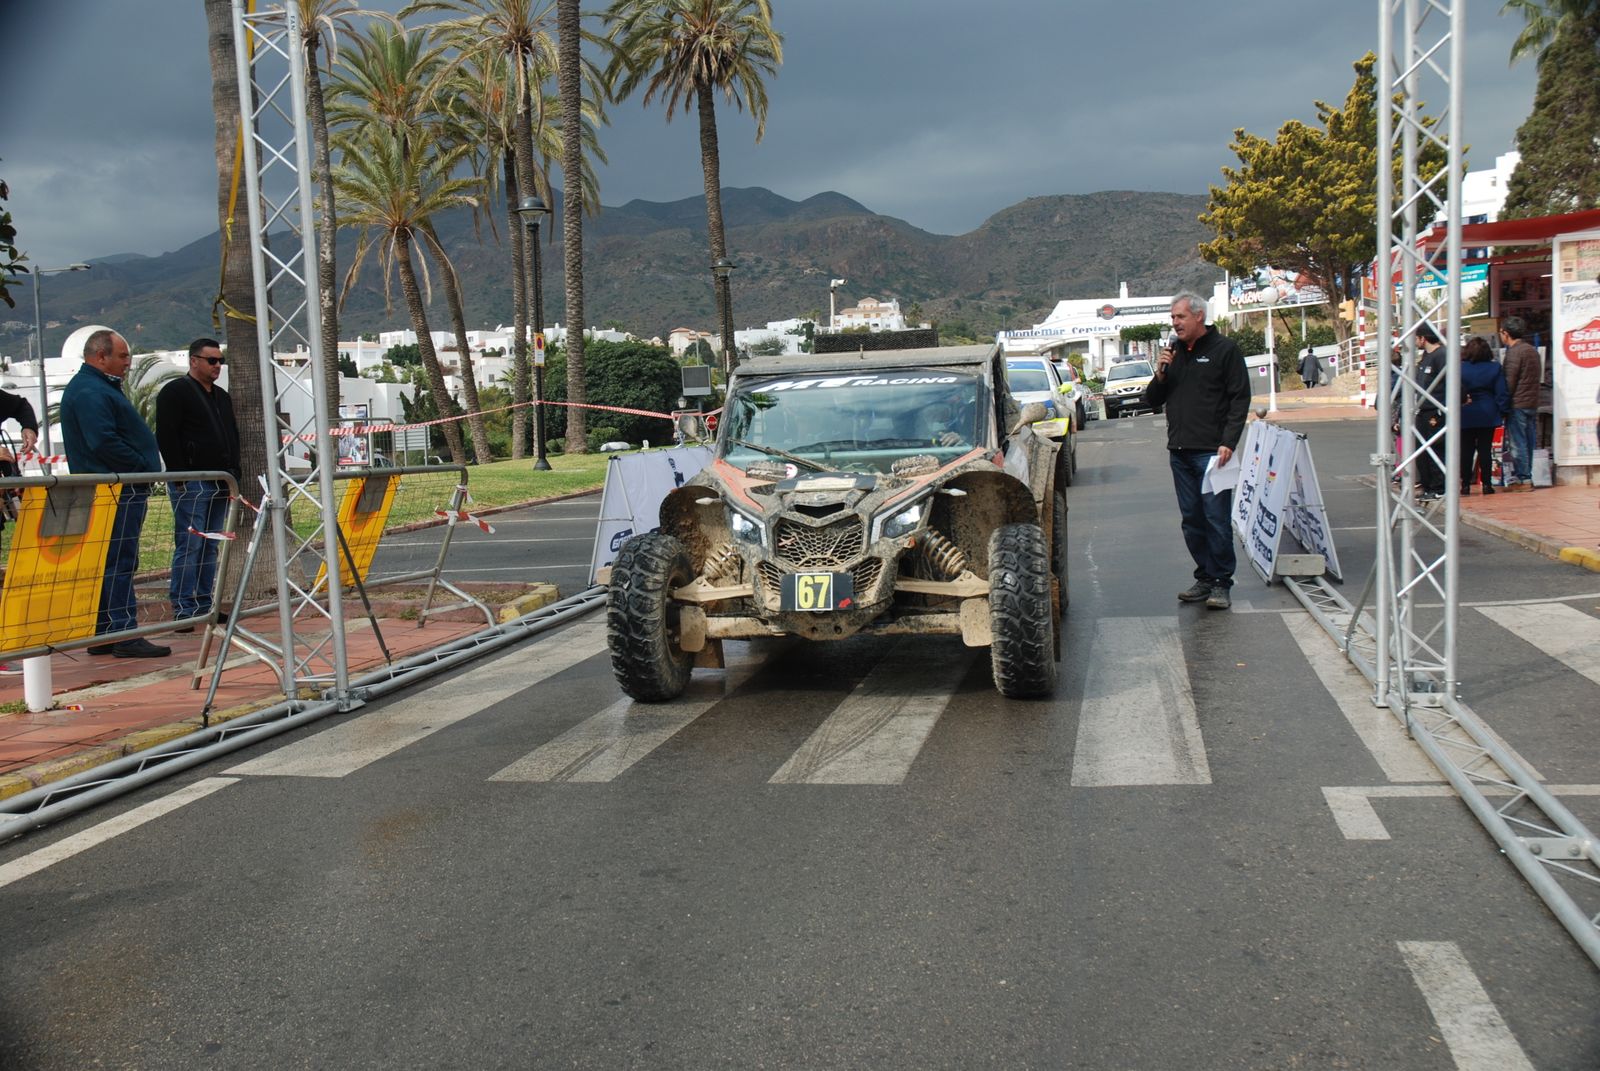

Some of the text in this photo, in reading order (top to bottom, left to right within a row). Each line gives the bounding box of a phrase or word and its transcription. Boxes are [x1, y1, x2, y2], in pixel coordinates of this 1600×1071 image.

[1587, 342, 1600, 351] SA
[851, 376, 958, 387] RACING
[798, 575, 830, 609] 67
